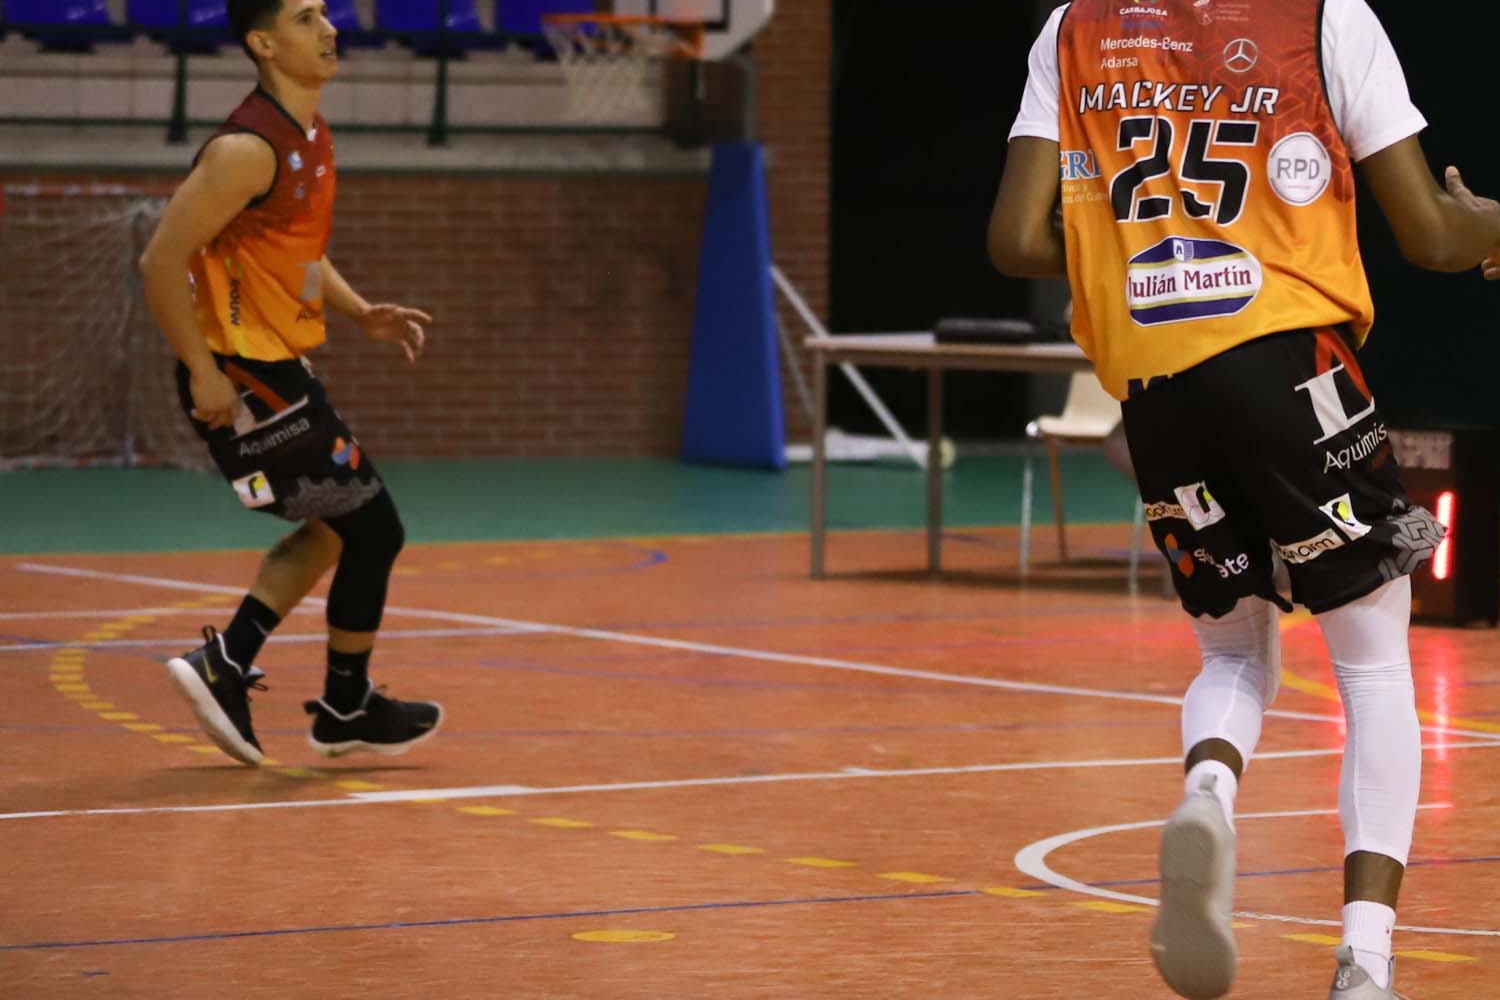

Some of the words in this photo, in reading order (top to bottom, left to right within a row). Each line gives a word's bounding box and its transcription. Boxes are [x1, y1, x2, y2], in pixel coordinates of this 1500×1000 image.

[1101, 35, 1193, 52] Mercedes-Benz
[1101, 56, 1138, 69] Adarsa
[1079, 80, 1223, 114] MACKEY
[1230, 86, 1280, 115] JR
[1109, 114, 1260, 228] 25
[1277, 158, 1321, 181] RPD
[1183, 266, 1252, 291] Martín
[1323, 422, 1388, 475] Aquimis
